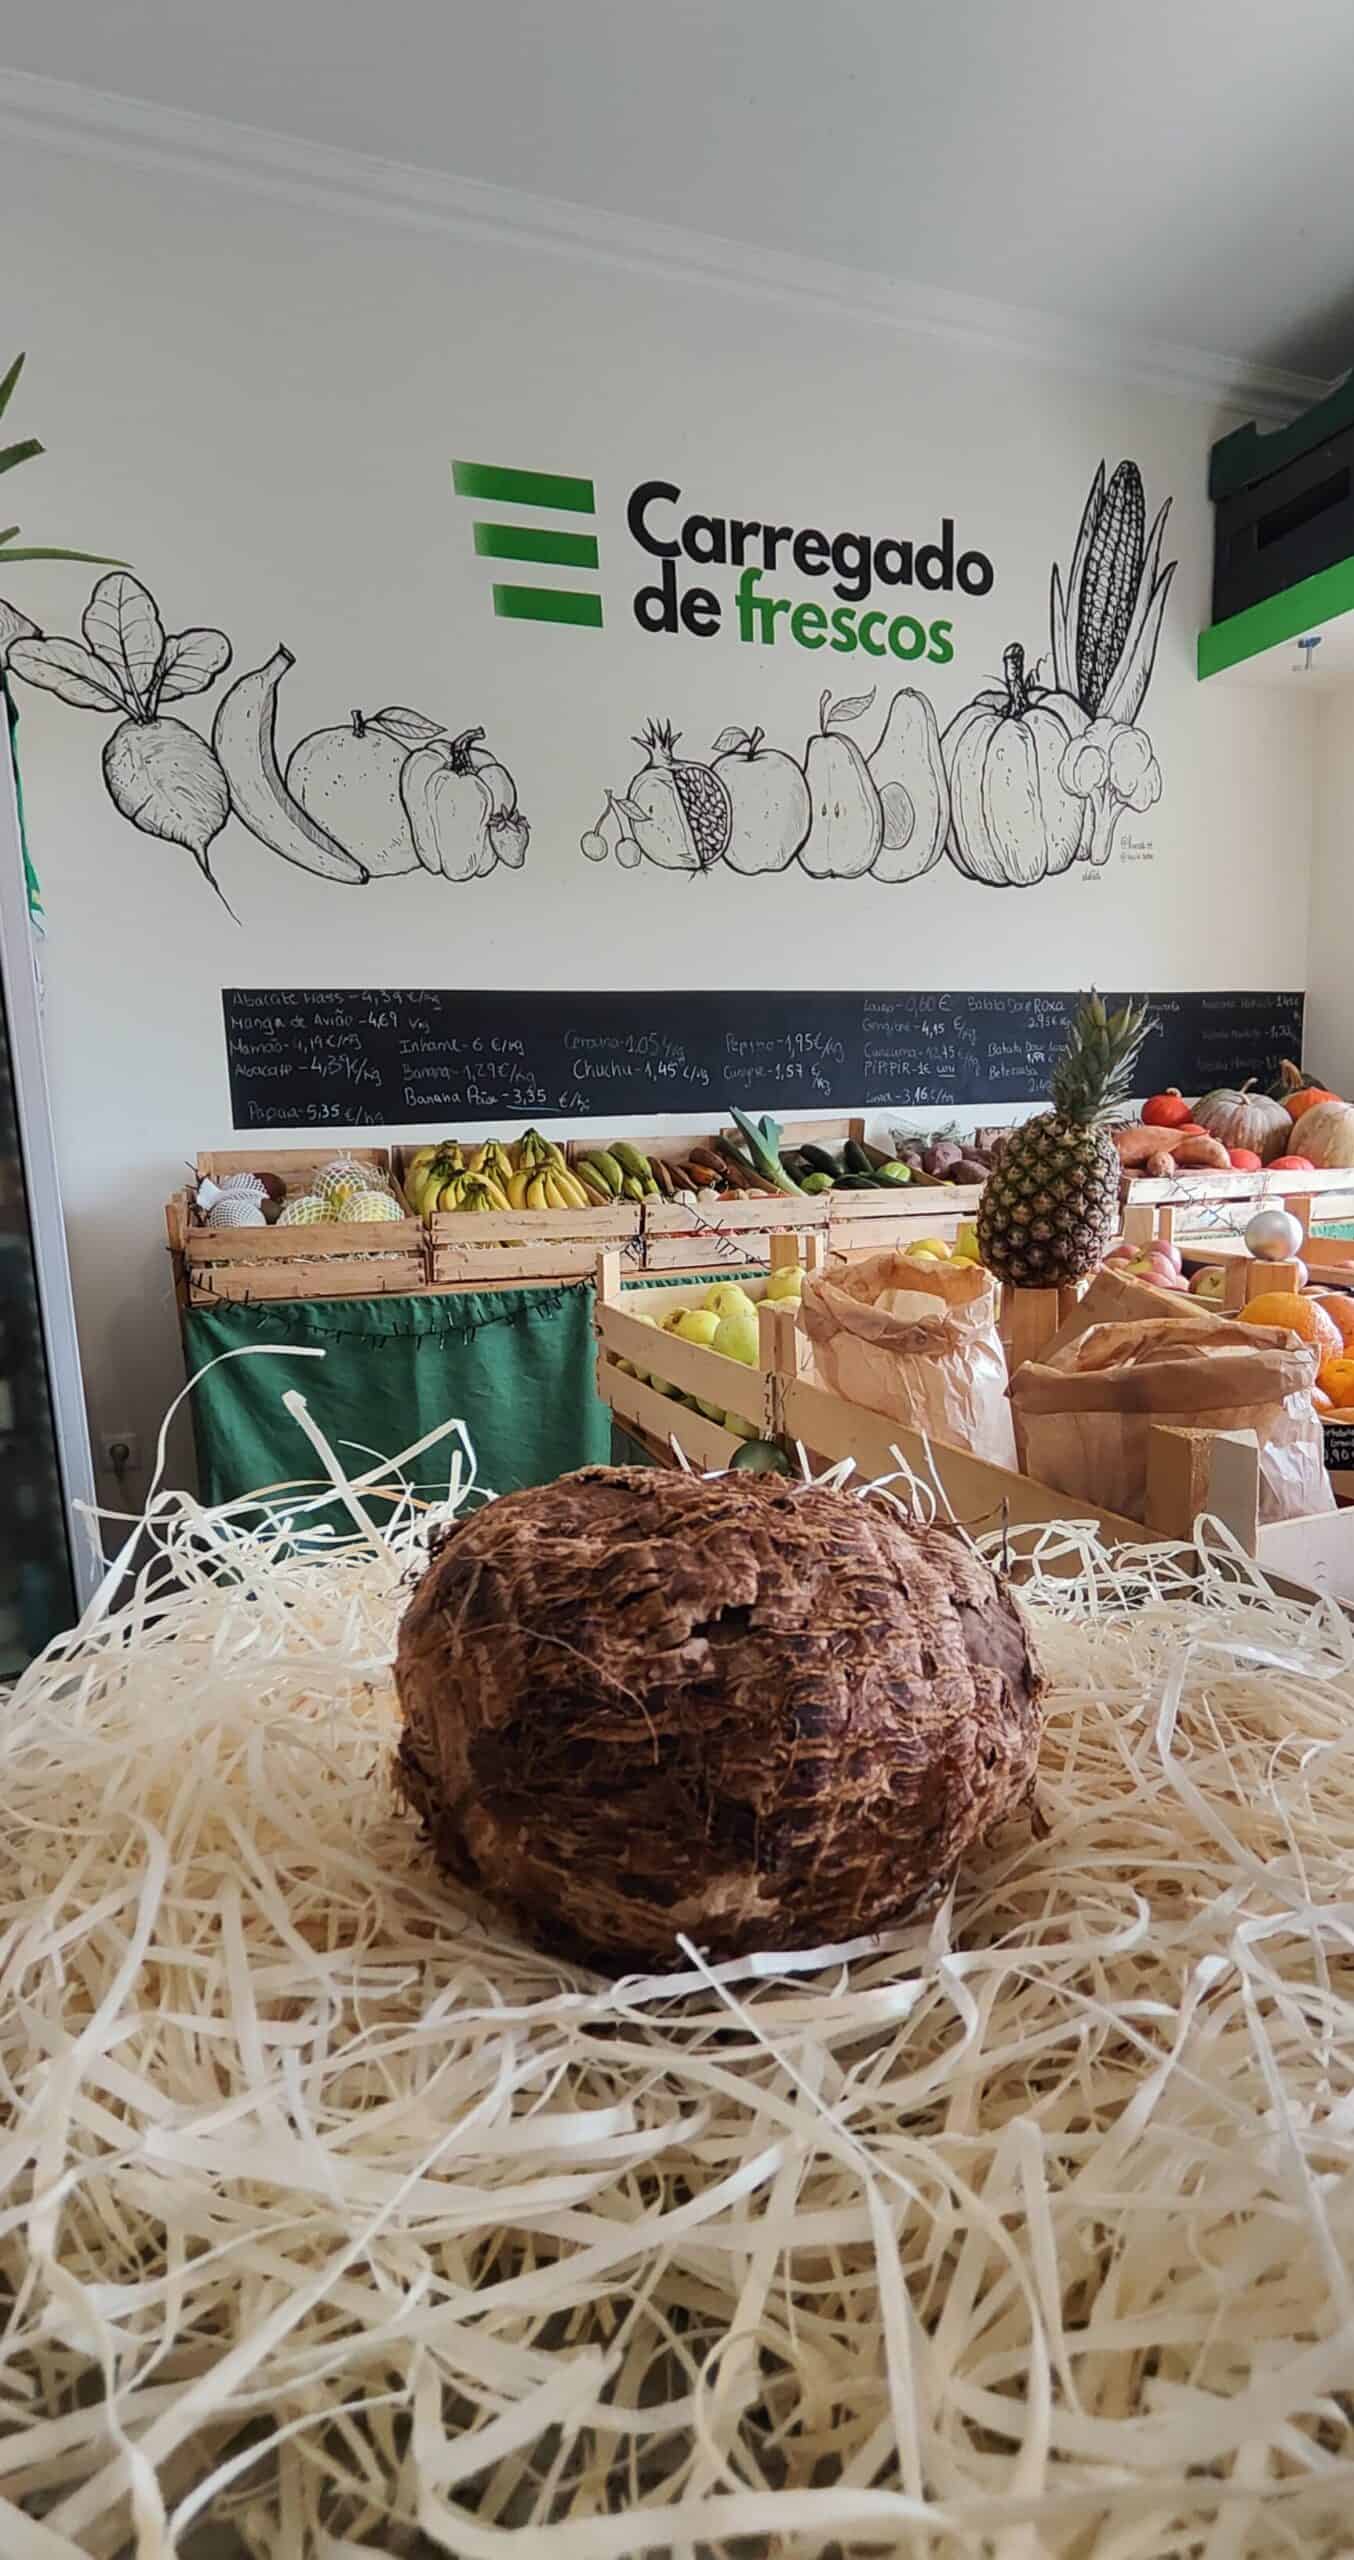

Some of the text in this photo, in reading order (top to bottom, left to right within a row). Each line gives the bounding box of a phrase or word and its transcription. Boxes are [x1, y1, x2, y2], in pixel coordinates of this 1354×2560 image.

[627, 481, 994, 602] Carregado
[633, 559, 954, 664] de frescos
[303, 991, 345, 1004] Hass
[403, 1086, 461, 1106] Banana
